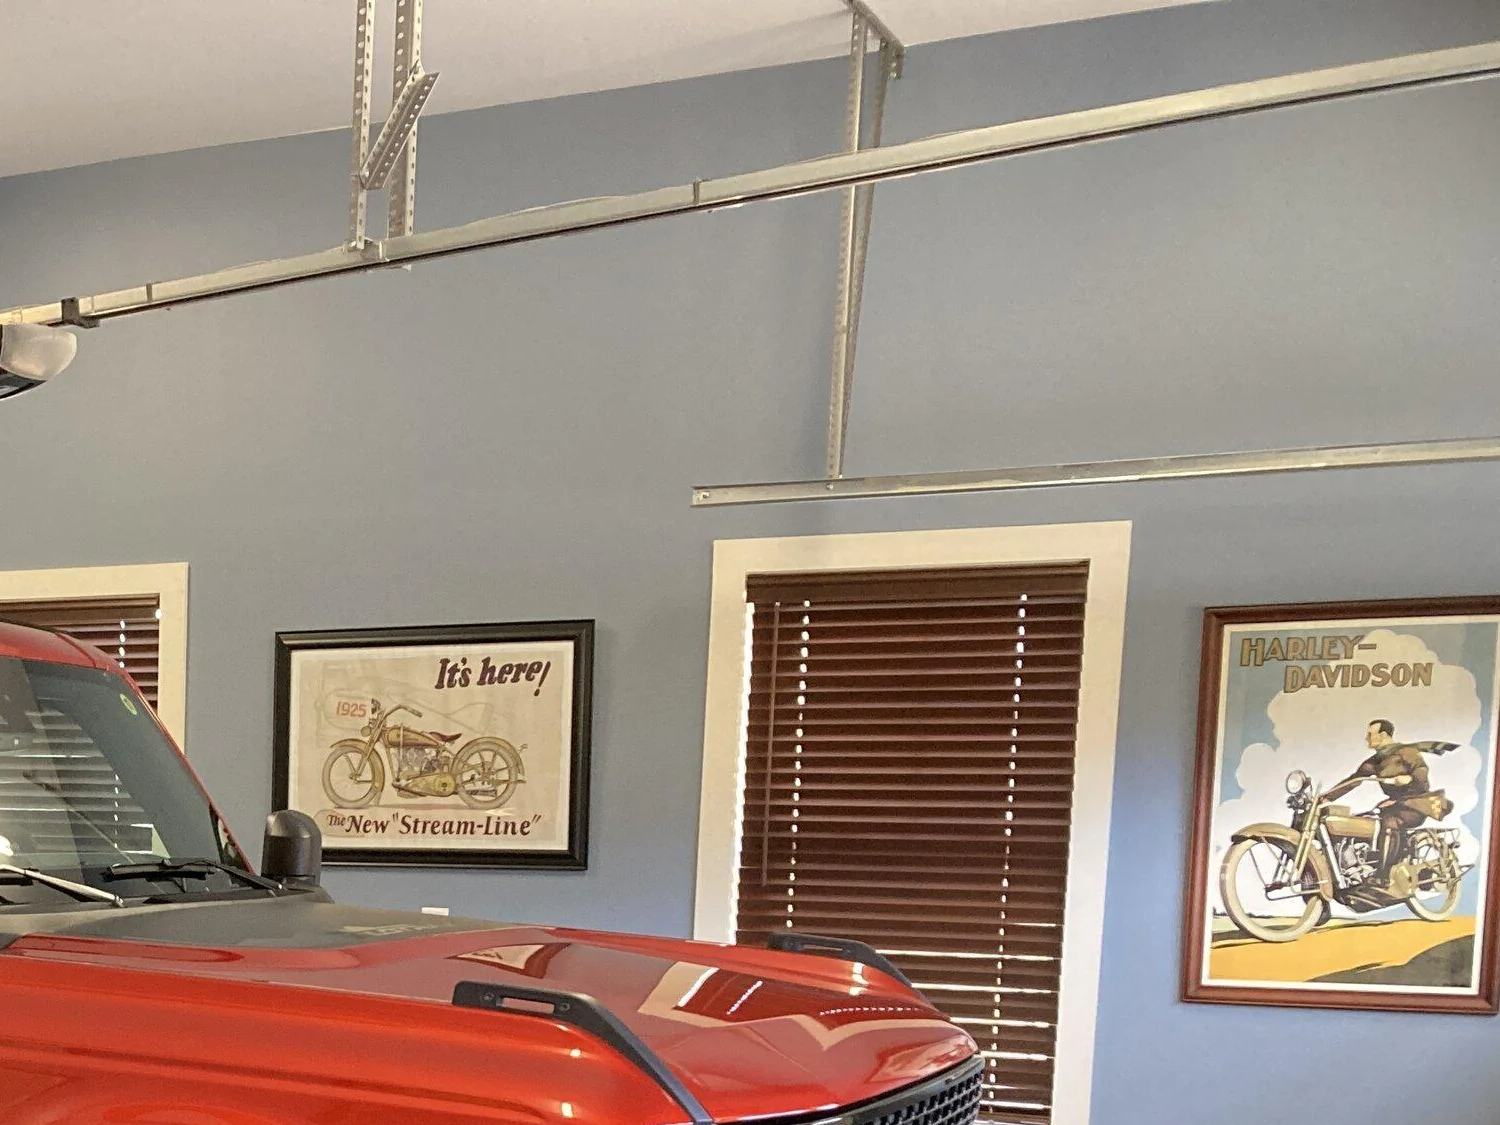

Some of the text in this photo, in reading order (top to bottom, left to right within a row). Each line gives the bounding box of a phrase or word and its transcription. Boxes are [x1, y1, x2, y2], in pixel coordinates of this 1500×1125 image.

[1240, 634, 1378, 667] HARLEY-
[434, 656, 551, 697] It's here!
[1283, 662, 1434, 694] DAVIDSON
[336, 701, 368, 718] 1925
[327, 814, 345, 827] The
[345, 815, 390, 834] New
